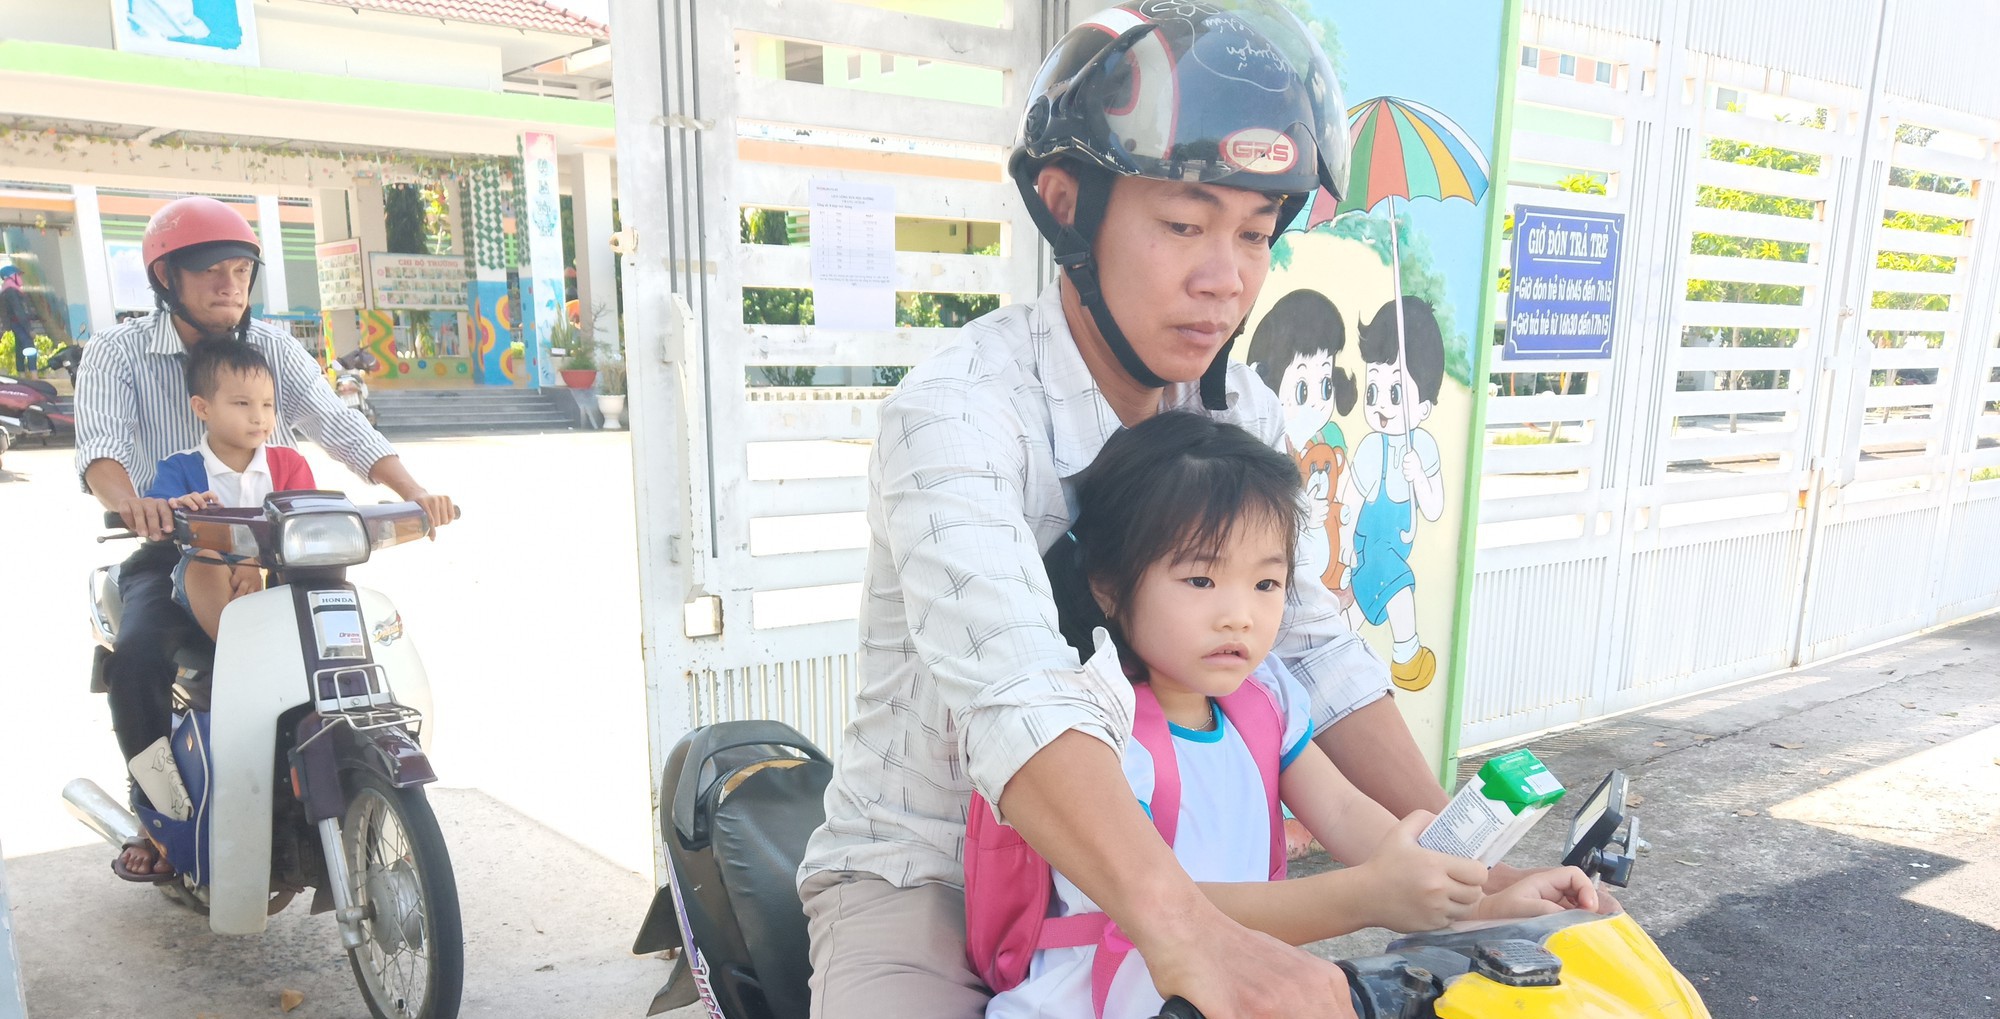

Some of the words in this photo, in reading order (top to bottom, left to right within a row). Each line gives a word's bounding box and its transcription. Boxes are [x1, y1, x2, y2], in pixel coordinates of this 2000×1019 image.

[1233, 141, 1289, 161] GRS
[1528, 221, 1547, 255] GIỜ
[1547, 222, 1568, 256] ĐÓN
[1569, 222, 1588, 257] TRẢ
[1590, 224, 1609, 258] TRẺ
[1532, 276, 1547, 300] đón
[1582, 276, 1596, 301] đến
[1596, 279, 1612, 302] 7h15
